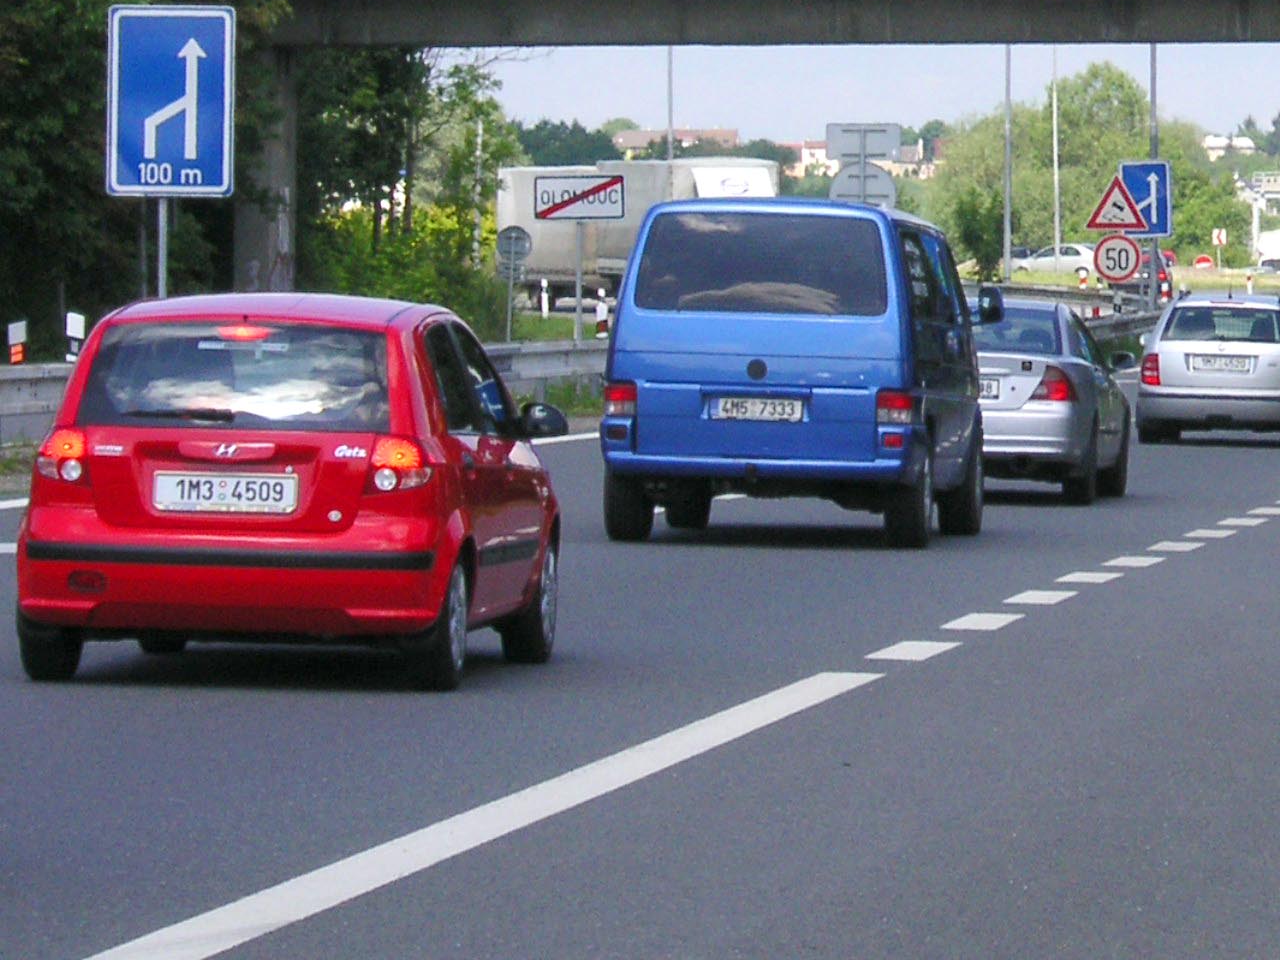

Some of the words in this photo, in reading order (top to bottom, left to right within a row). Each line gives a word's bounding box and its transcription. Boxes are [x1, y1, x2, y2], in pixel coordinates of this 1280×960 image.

[138, 163, 172, 184] 100
[180, 168, 202, 184] m
[541, 189, 619, 205] OLOMOUC
[1106, 248, 1129, 271] 50
[721, 400, 748, 415] 4M5
[760, 401, 796, 417] 7333
[175, 479, 214, 501] 1M3
[230, 481, 284, 502] 4509
